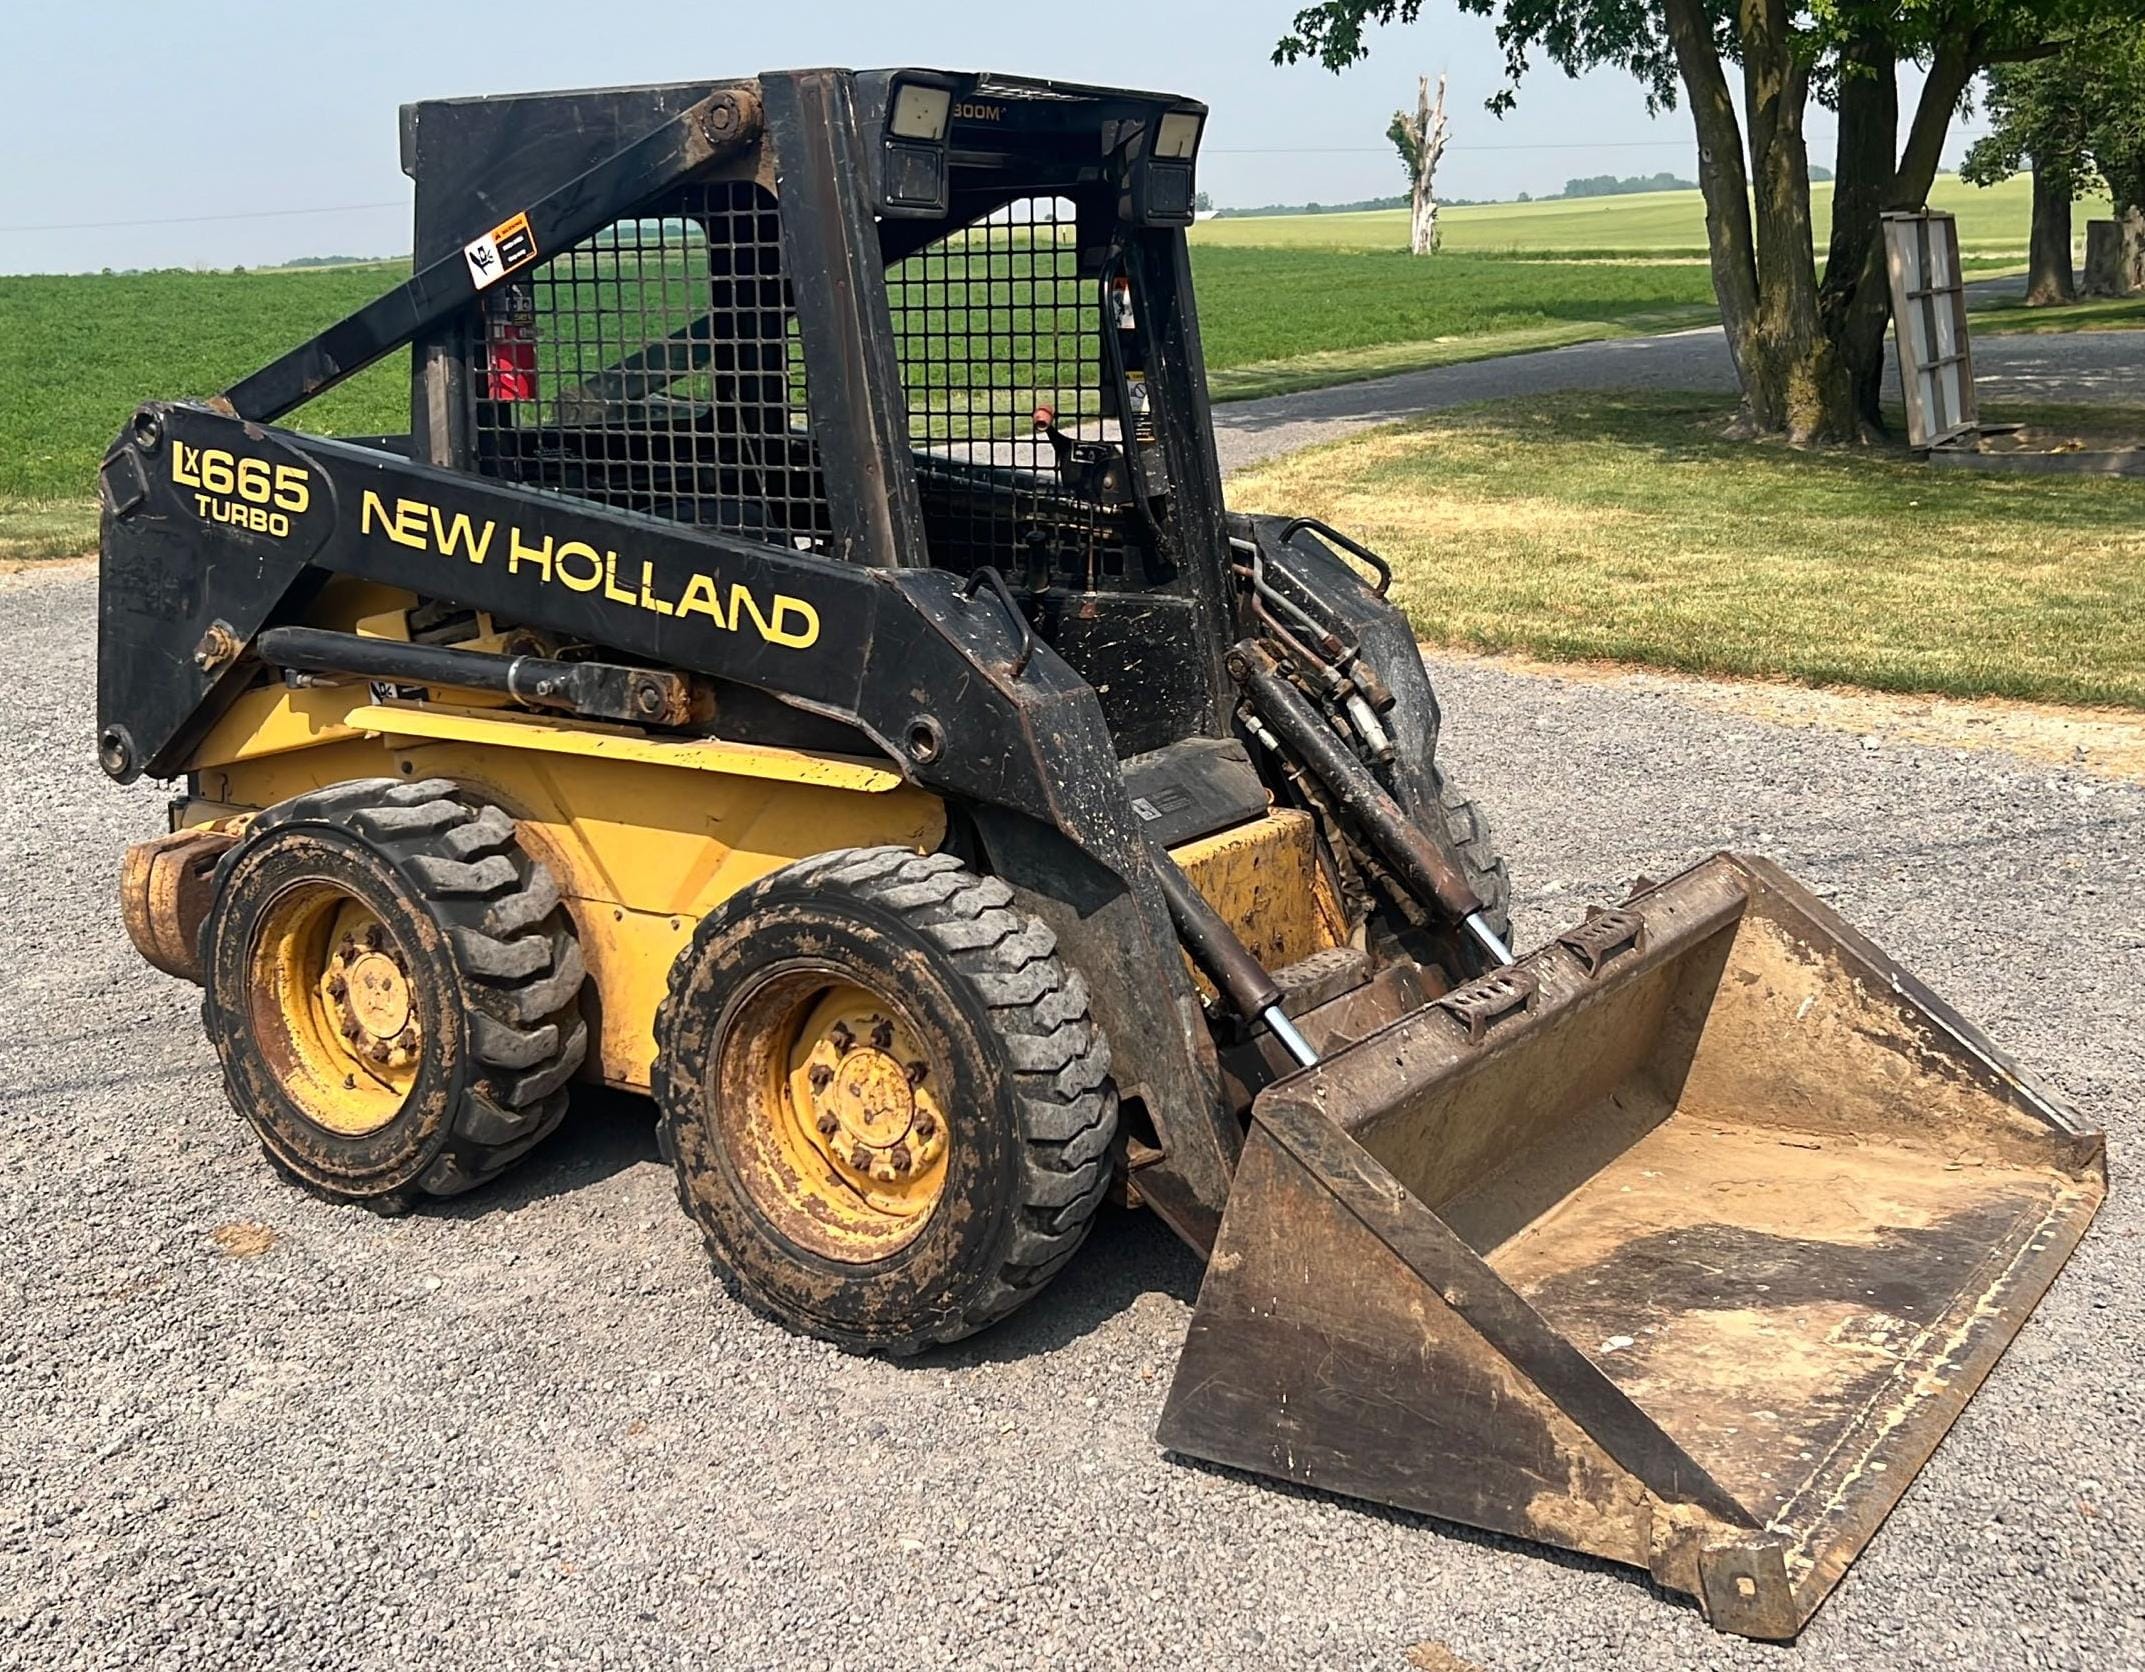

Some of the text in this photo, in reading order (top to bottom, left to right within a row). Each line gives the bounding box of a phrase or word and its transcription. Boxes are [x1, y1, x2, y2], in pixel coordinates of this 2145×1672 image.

[194, 493, 289, 537] TURBO
[361, 491, 821, 650] NEW HOLLAND
